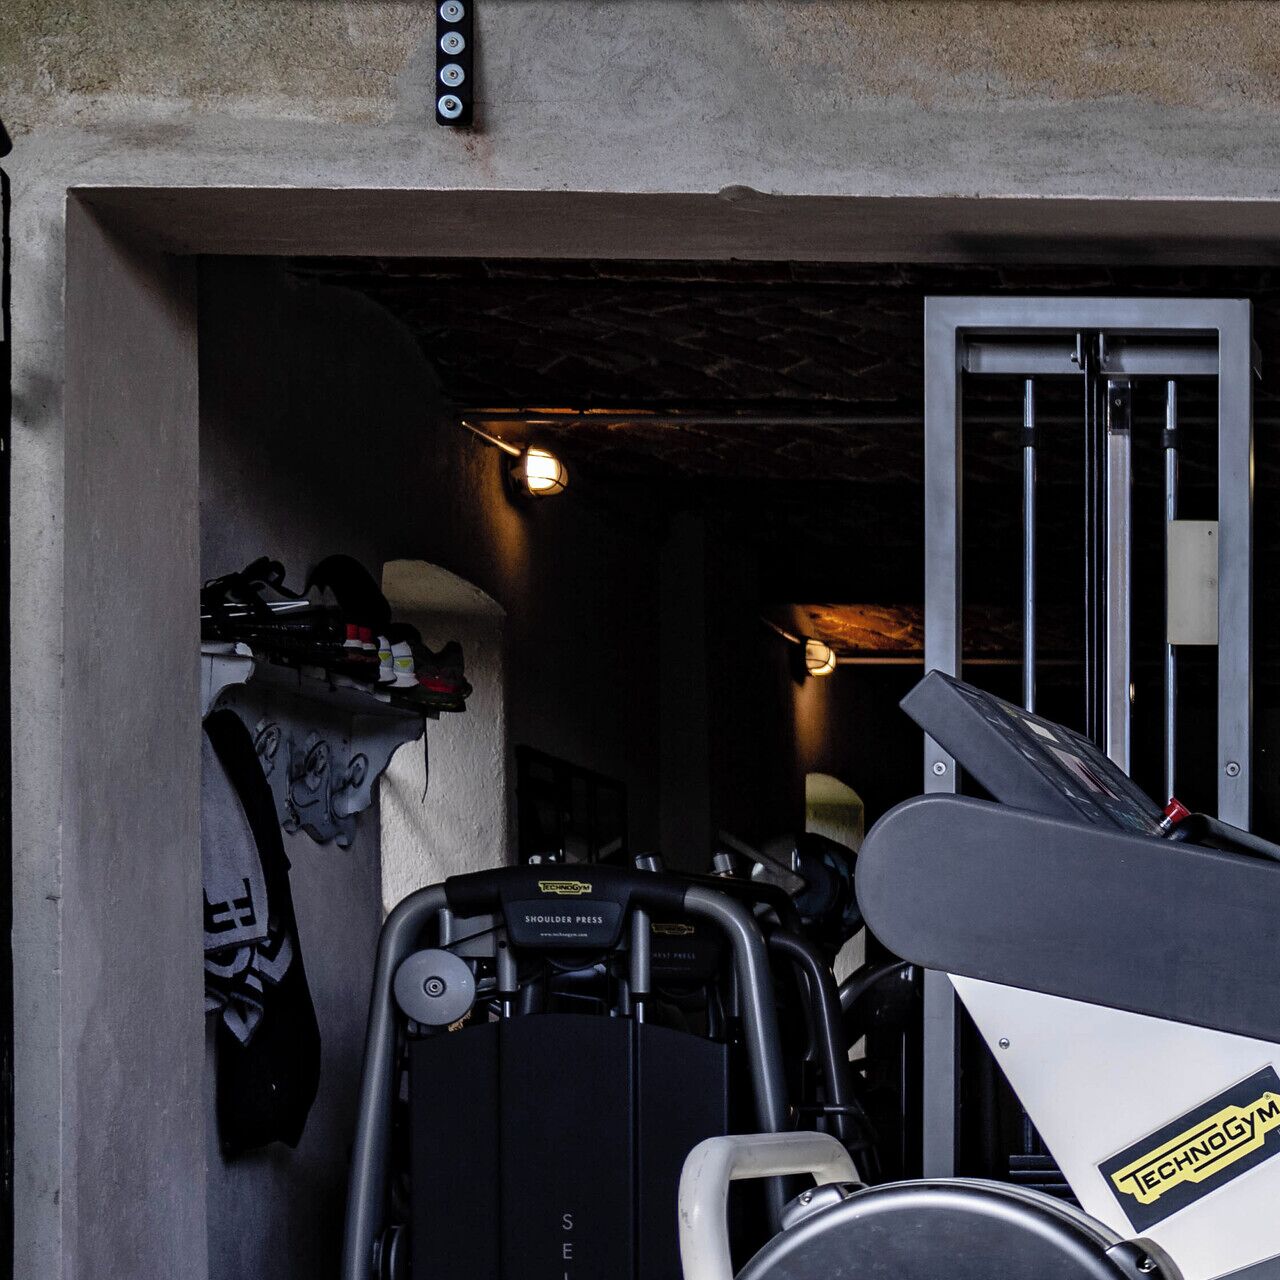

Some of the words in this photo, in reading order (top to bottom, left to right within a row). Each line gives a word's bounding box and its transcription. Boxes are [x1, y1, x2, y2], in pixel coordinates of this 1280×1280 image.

[525, 915, 572, 924] SHOULDER
[575, 916, 603, 924] PRESS
[1119, 1100, 1280, 1196] TECHNOGYM
